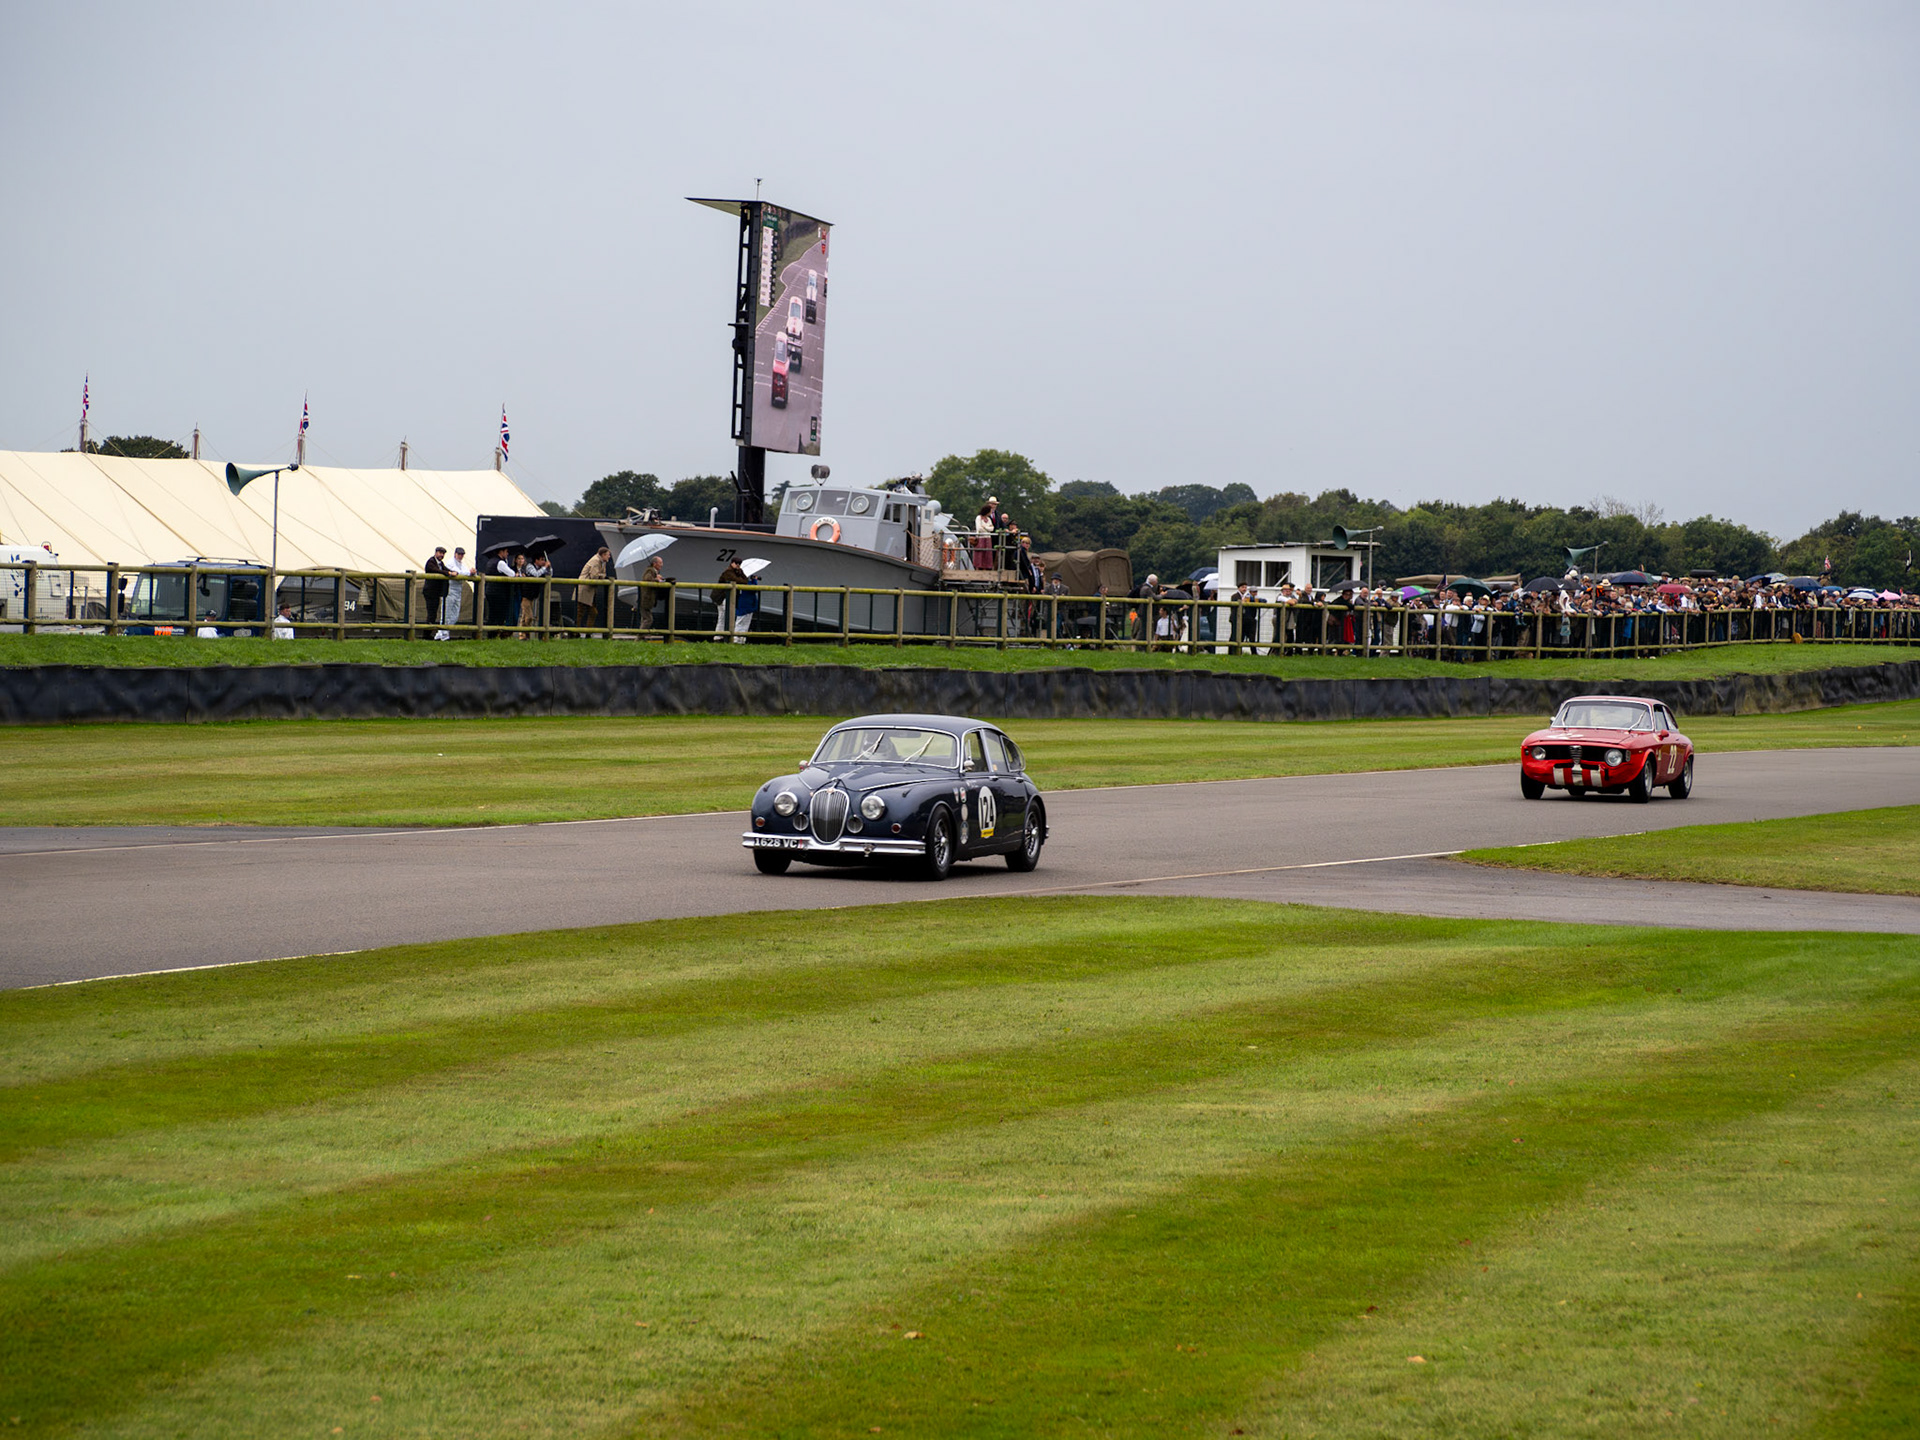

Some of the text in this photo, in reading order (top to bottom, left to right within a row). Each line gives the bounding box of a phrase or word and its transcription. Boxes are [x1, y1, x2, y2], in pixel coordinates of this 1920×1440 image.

[716, 548, 736, 562] 27
[344, 600, 355, 611] 94
[1667, 744, 1677, 774] 22
[979, 795, 995, 830] 124
[754, 837, 798, 849] 1628 VC
